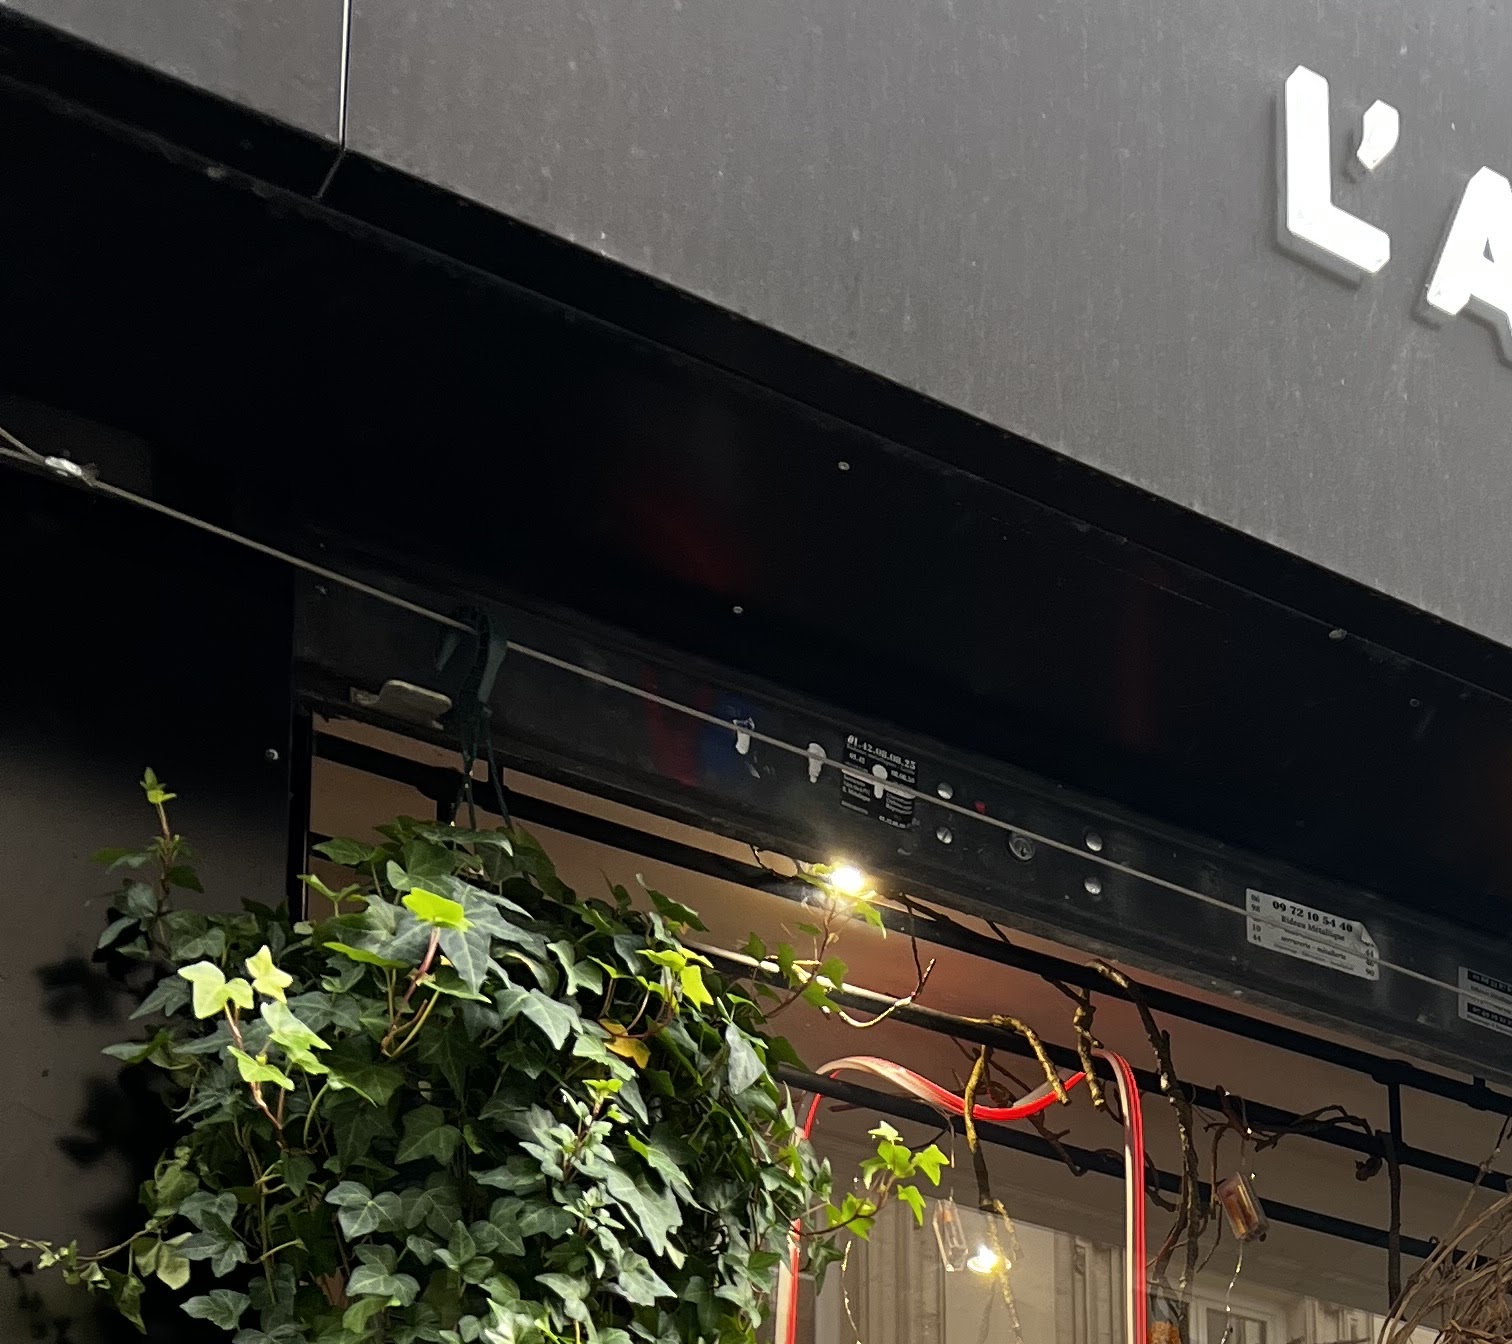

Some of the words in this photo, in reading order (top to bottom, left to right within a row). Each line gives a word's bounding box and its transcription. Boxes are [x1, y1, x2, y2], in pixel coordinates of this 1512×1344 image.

[1272, 901, 1286, 911] 09
[1289, 906, 1304, 917] 72
[1307, 911, 1319, 922] 10
